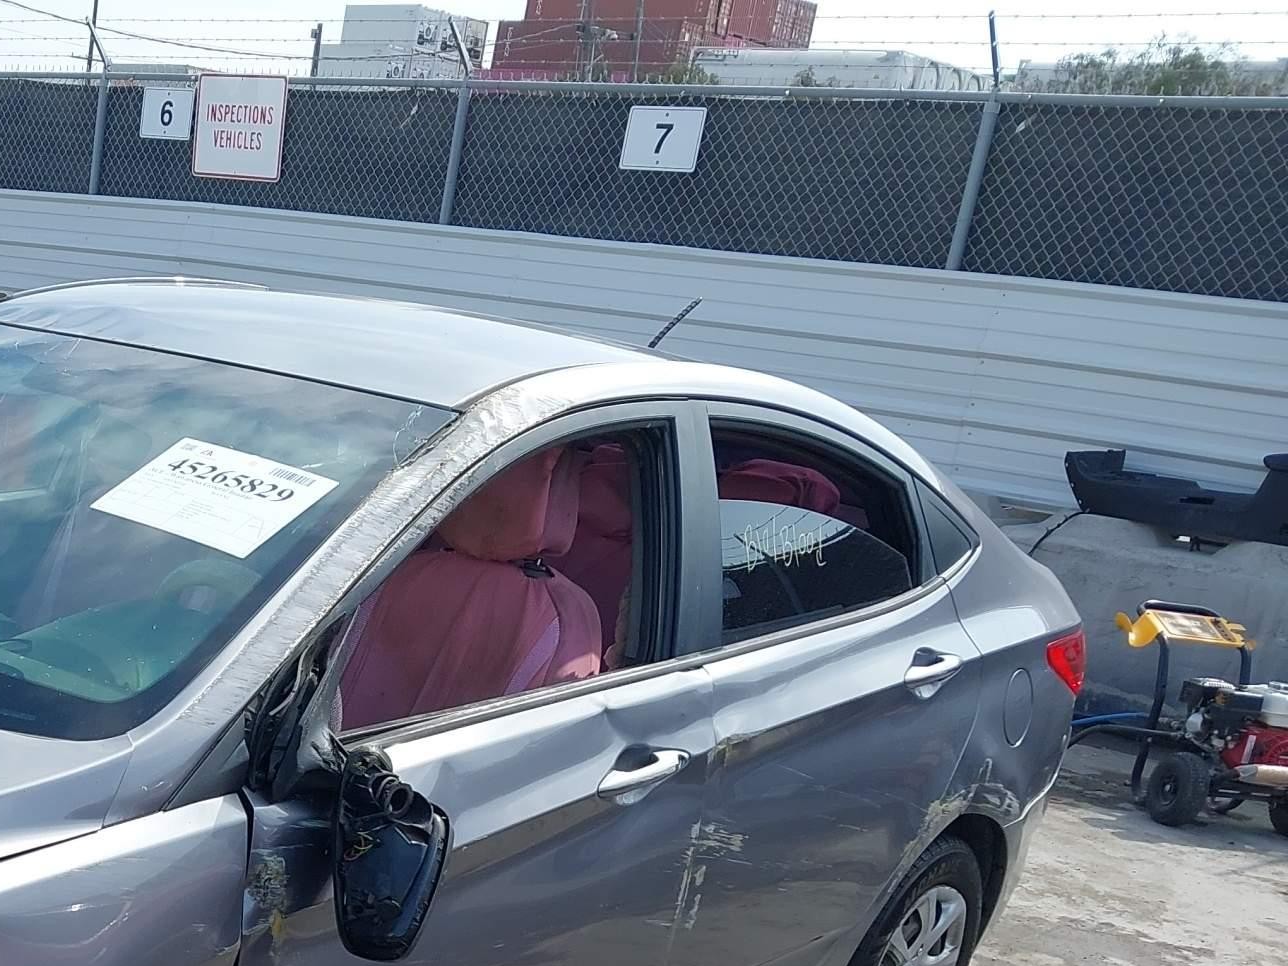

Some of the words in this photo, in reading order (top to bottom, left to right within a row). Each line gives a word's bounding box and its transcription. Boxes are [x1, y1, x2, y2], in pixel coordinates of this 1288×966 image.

[160, 100, 174, 127] 6
[206, 103, 274, 125] INSPECTIONS
[213, 129, 263, 150] VEHICLES
[654, 123, 675, 154] 7
[167, 458, 295, 502] 45265829
